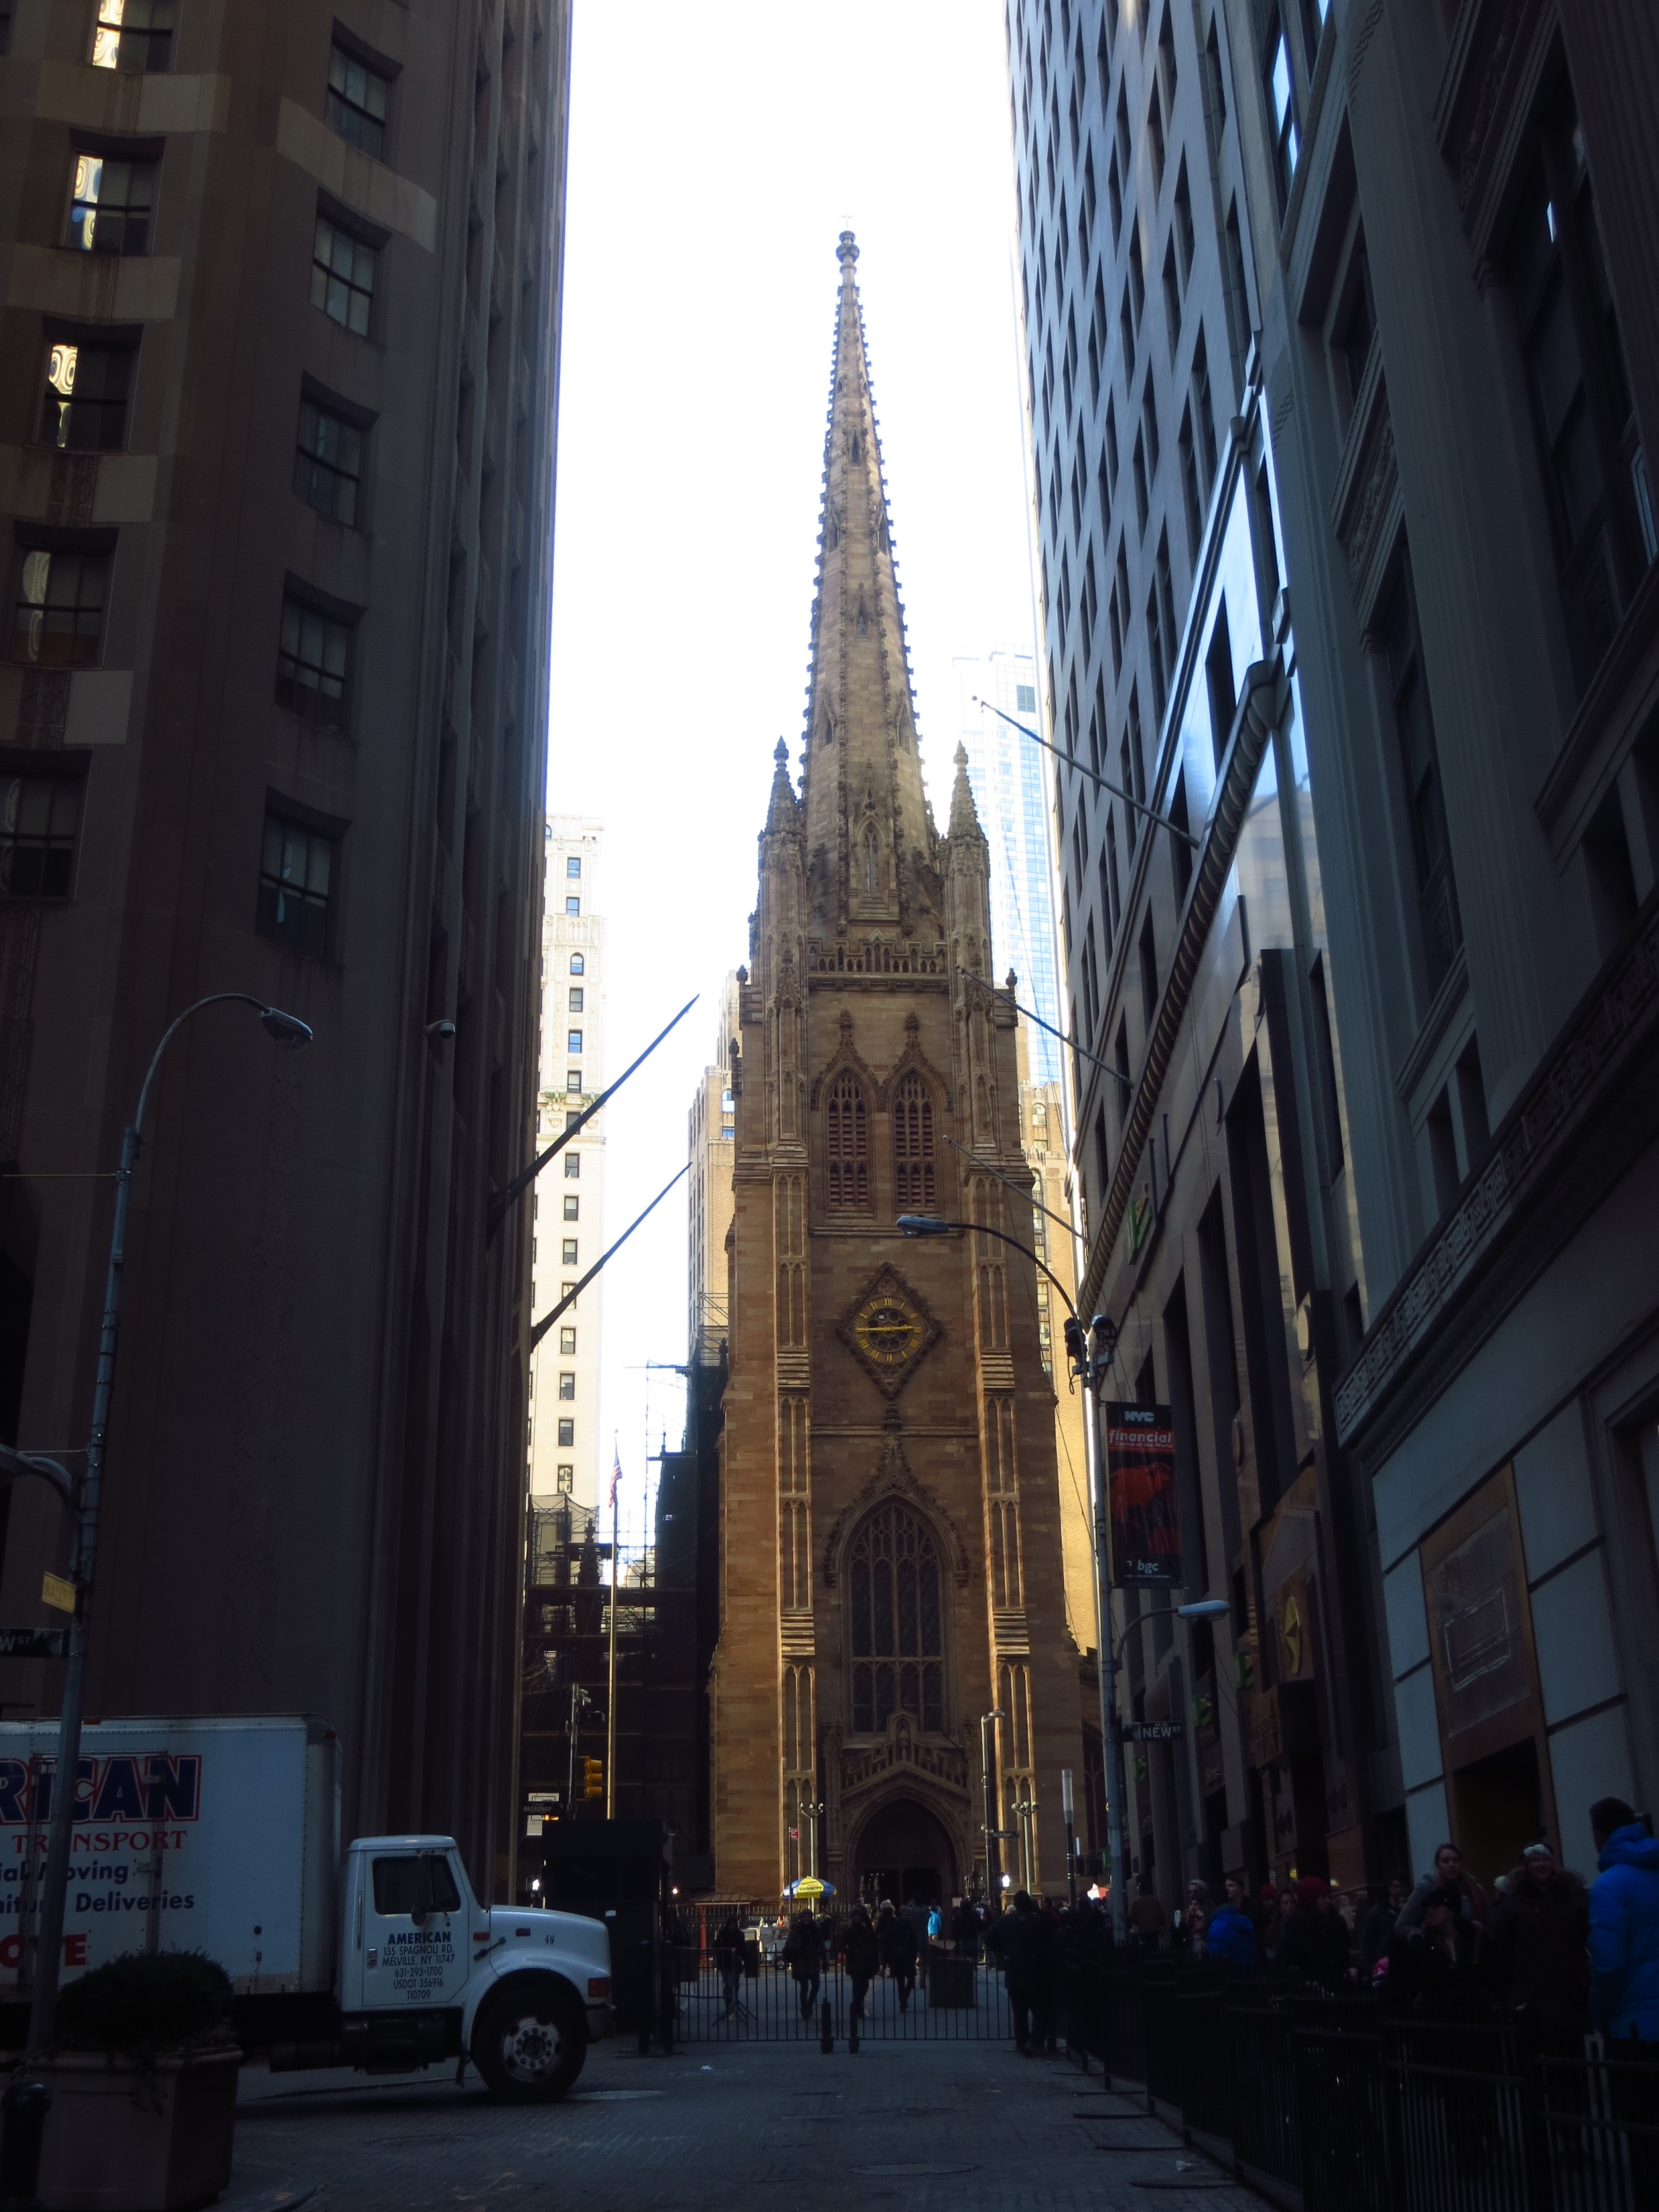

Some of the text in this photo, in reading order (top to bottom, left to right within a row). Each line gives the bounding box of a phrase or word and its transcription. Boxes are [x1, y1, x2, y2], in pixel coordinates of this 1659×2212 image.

[1124, 1410, 1154, 1422] NYC
[1108, 1430, 1172, 1443] financial
[1137, 1559, 1159, 1574] bgc
[17, 1636, 31, 1645] ST
[1142, 1727, 1171, 1738] NEW
[12, 1830, 187, 1854] TRNSPORT
[75, 1891, 194, 1913] Deliveries
[388, 1931, 451, 1945] AMERICAN
[545, 1935, 555, 1945] 49
[384, 1944, 455, 1956] 135 SPAGNOLI RD.
[382, 1954, 455, 1967] MELVILLE, NY 11747
[395, 1966, 443, 1978] 631-293-1700
[394, 1978, 444, 1989] USDOT 356916
